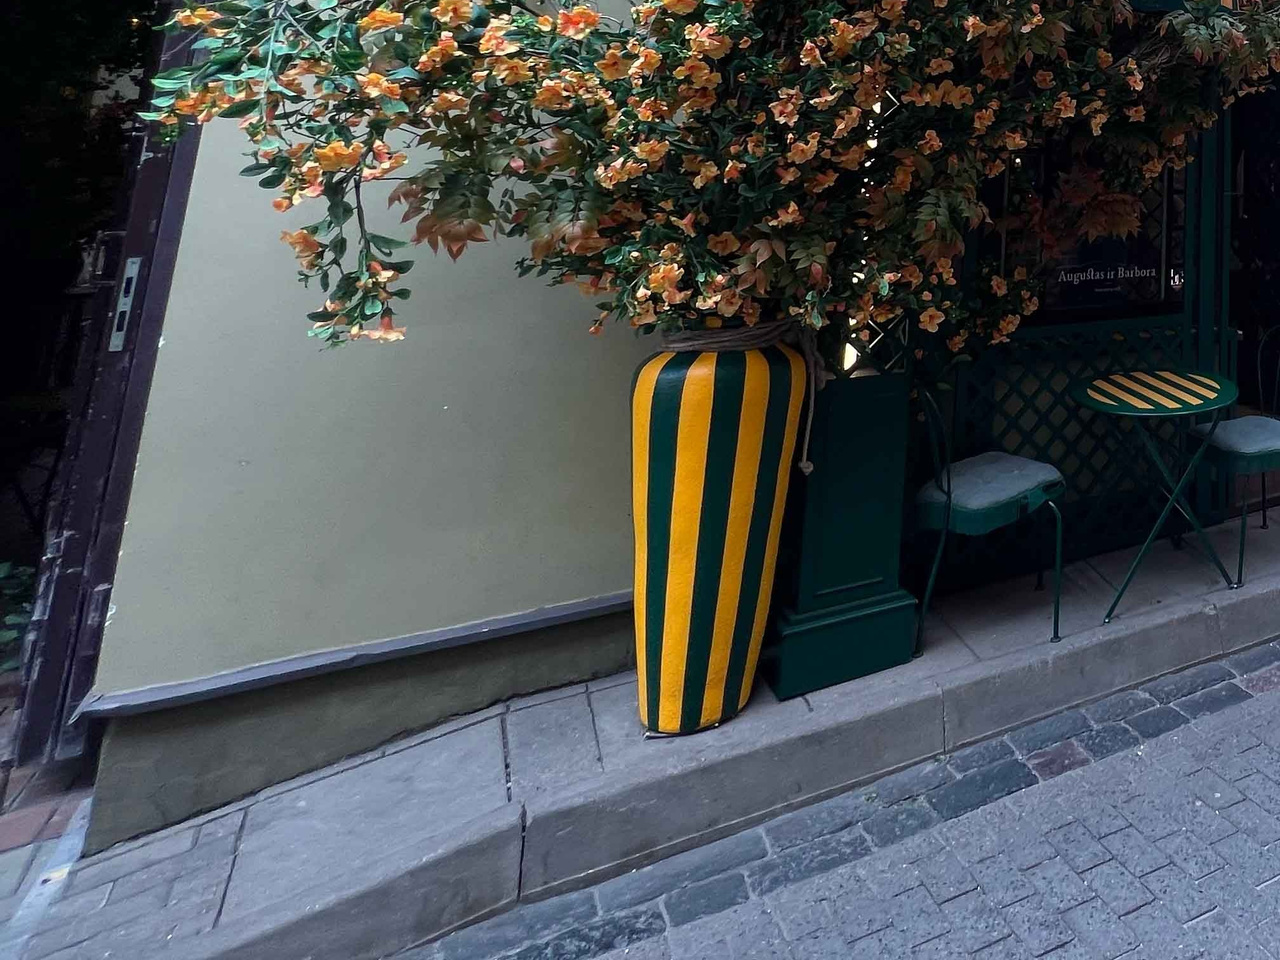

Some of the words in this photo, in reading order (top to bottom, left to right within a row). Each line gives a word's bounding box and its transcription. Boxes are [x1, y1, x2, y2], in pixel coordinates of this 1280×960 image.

[1058, 268, 1105, 284] Augustas
[1106, 267, 1116, 280] ir
[1117, 266, 1157, 279] Barbora
